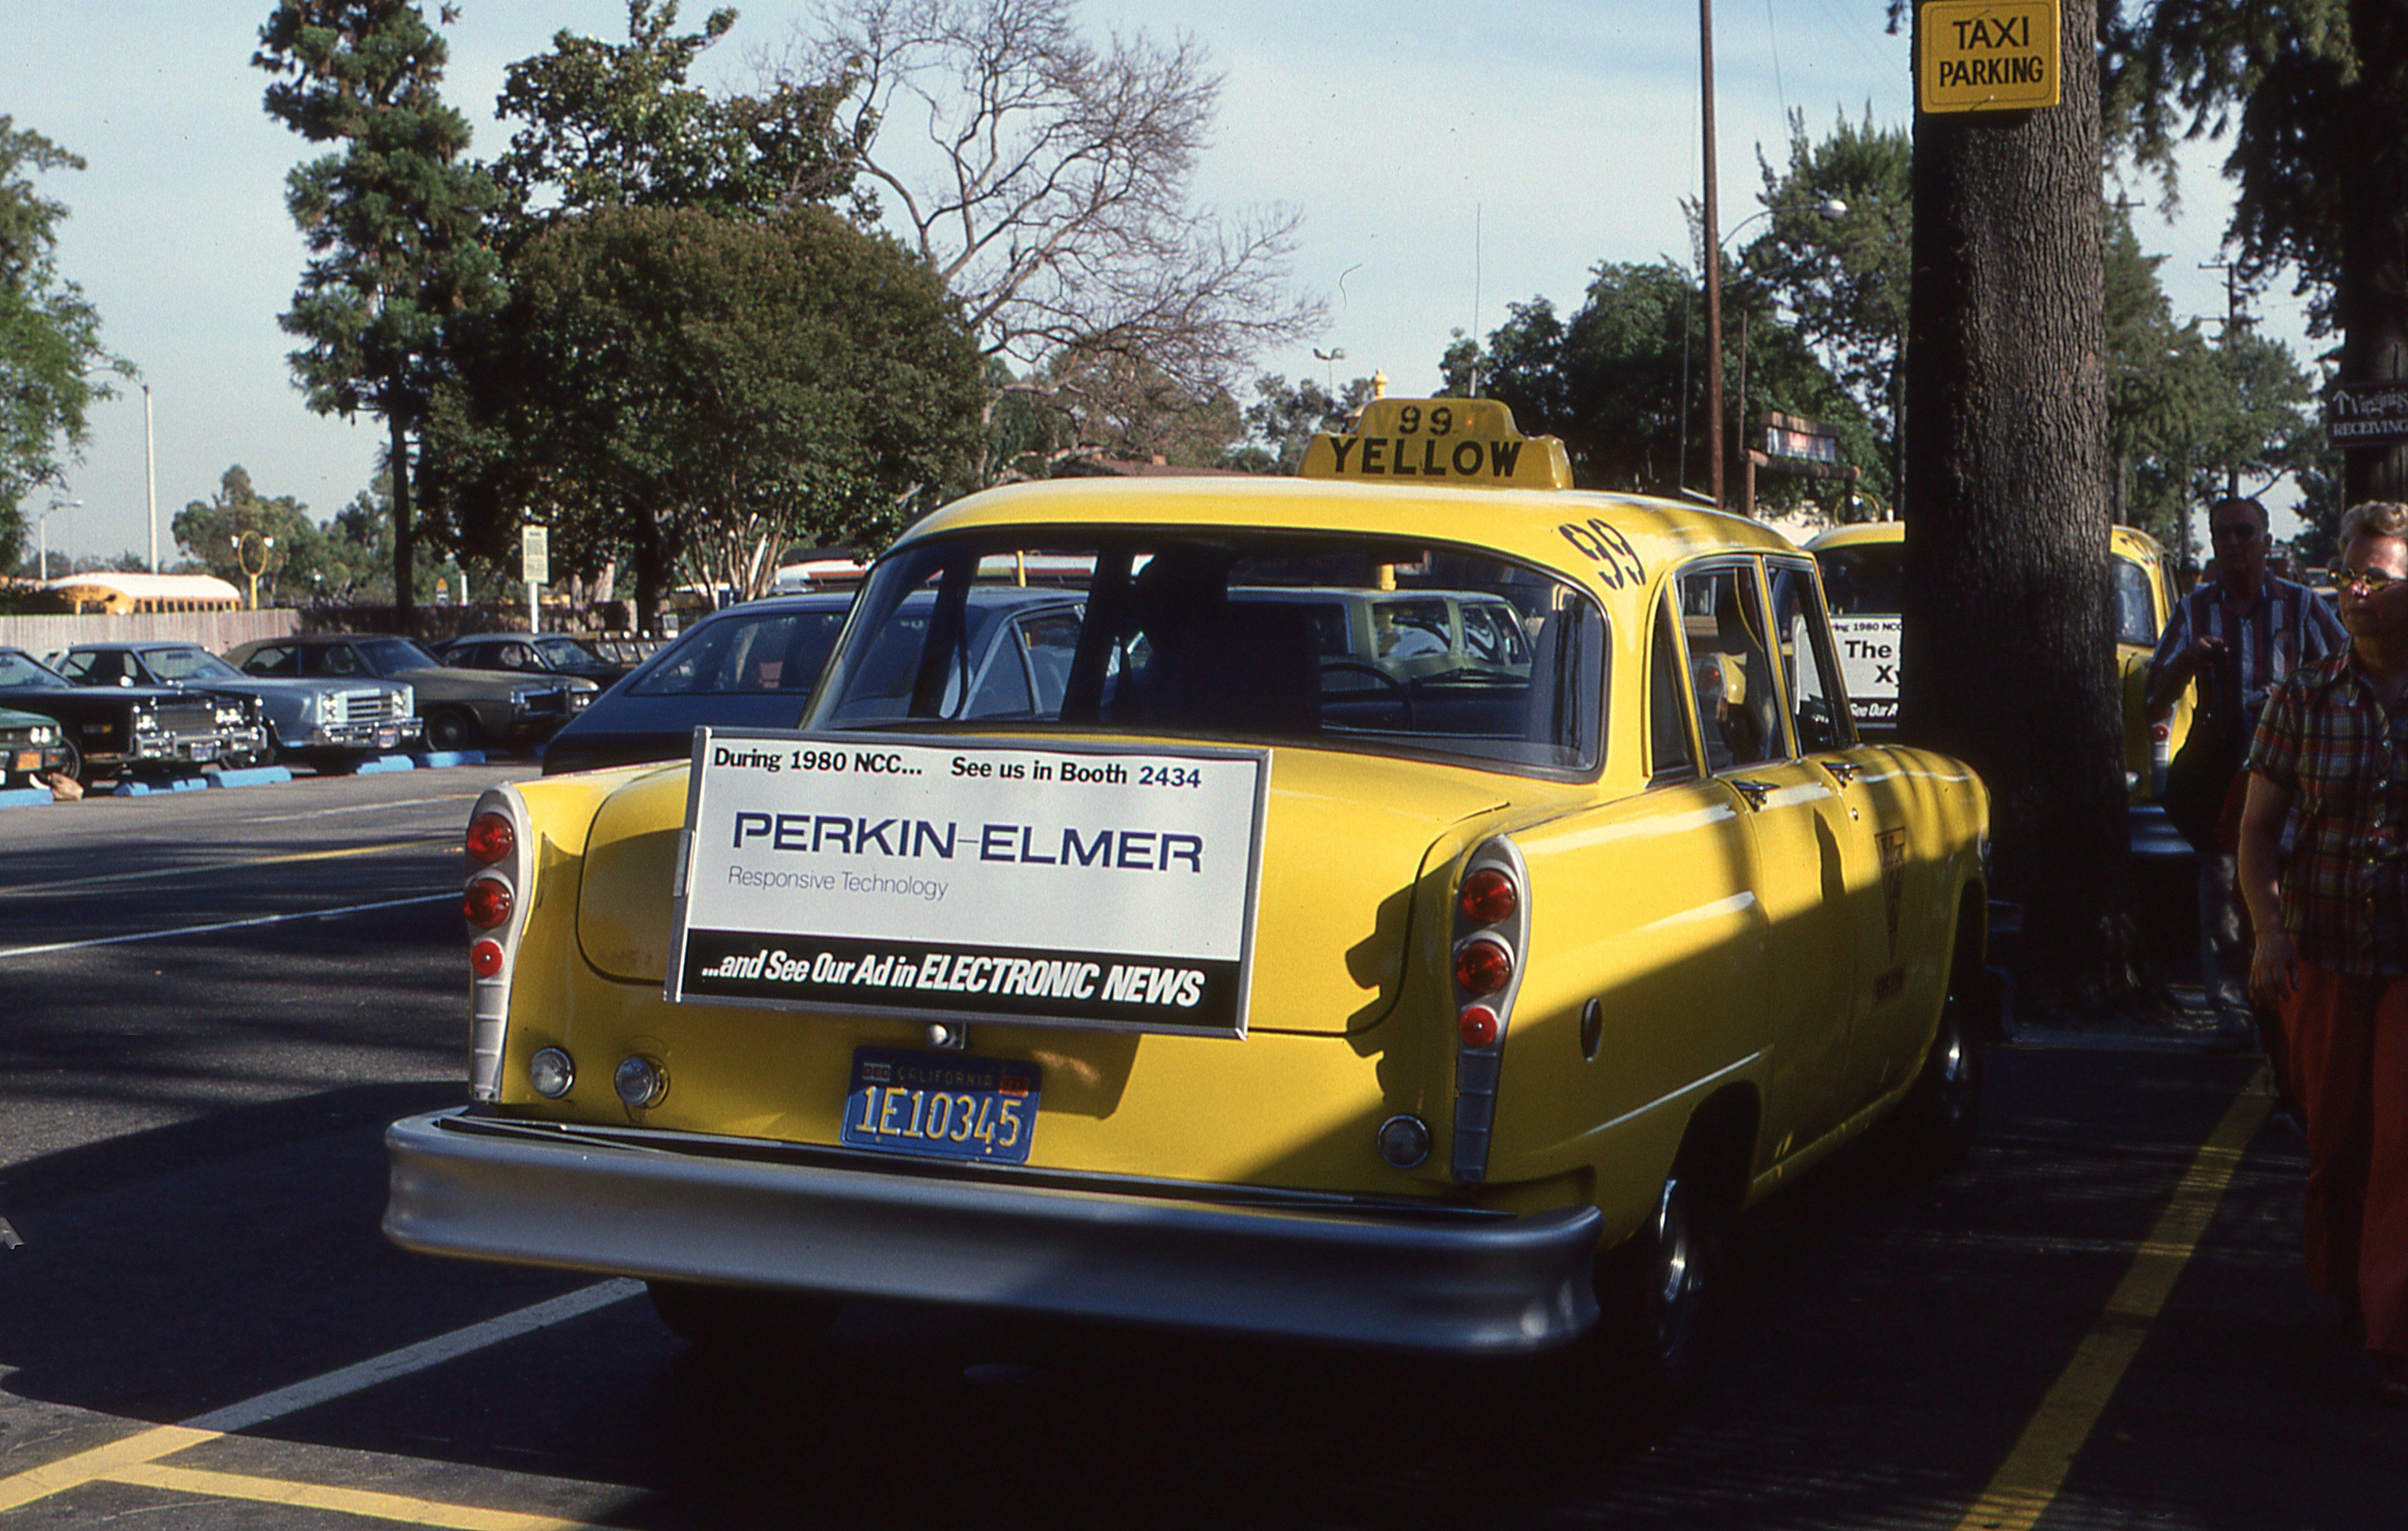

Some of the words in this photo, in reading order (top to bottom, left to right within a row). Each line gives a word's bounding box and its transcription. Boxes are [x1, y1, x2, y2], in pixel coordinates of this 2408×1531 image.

[1952, 16, 2029, 50] TAXI
[1940, 55, 2043, 87] PARKING
[1399, 405, 1453, 436] 99
[1330, 437, 1523, 478] YELLOW
[1558, 517, 1646, 590] 99
[1854, 622, 1879, 631] 1980
[1845, 640, 1892, 659] The
[1850, 703, 1868, 718] See
[1869, 703, 1889, 718] Our
[715, 747, 783, 772] During
[790, 750, 847, 772] 1980
[853, 753, 923, 775] NCC...
[951, 756, 993, 778] See
[999, 763, 1026, 779] us
[1033, 760, 1053, 781] in
[1060, 761, 1128, 784] Booth
[1138, 765, 1202, 788] 2434
[731, 811, 1203, 874] PERKIN-ELMER
[728, 865, 836, 891] Responsive
[841, 871, 949, 902] Technology
[701, 949, 769, 979] ...and
[764, 950, 811, 983] See
[811, 952, 856, 985] Our
[852, 955, 895, 987] Ad
[890, 956, 918, 989] in
[915, 953, 1101, 1000] ELECTRONIC
[1100, 964, 1206, 1008] NEWS
[898, 1066, 993, 1087] CALIFORNIA
[855, 1085, 1022, 1148] 1E10345
